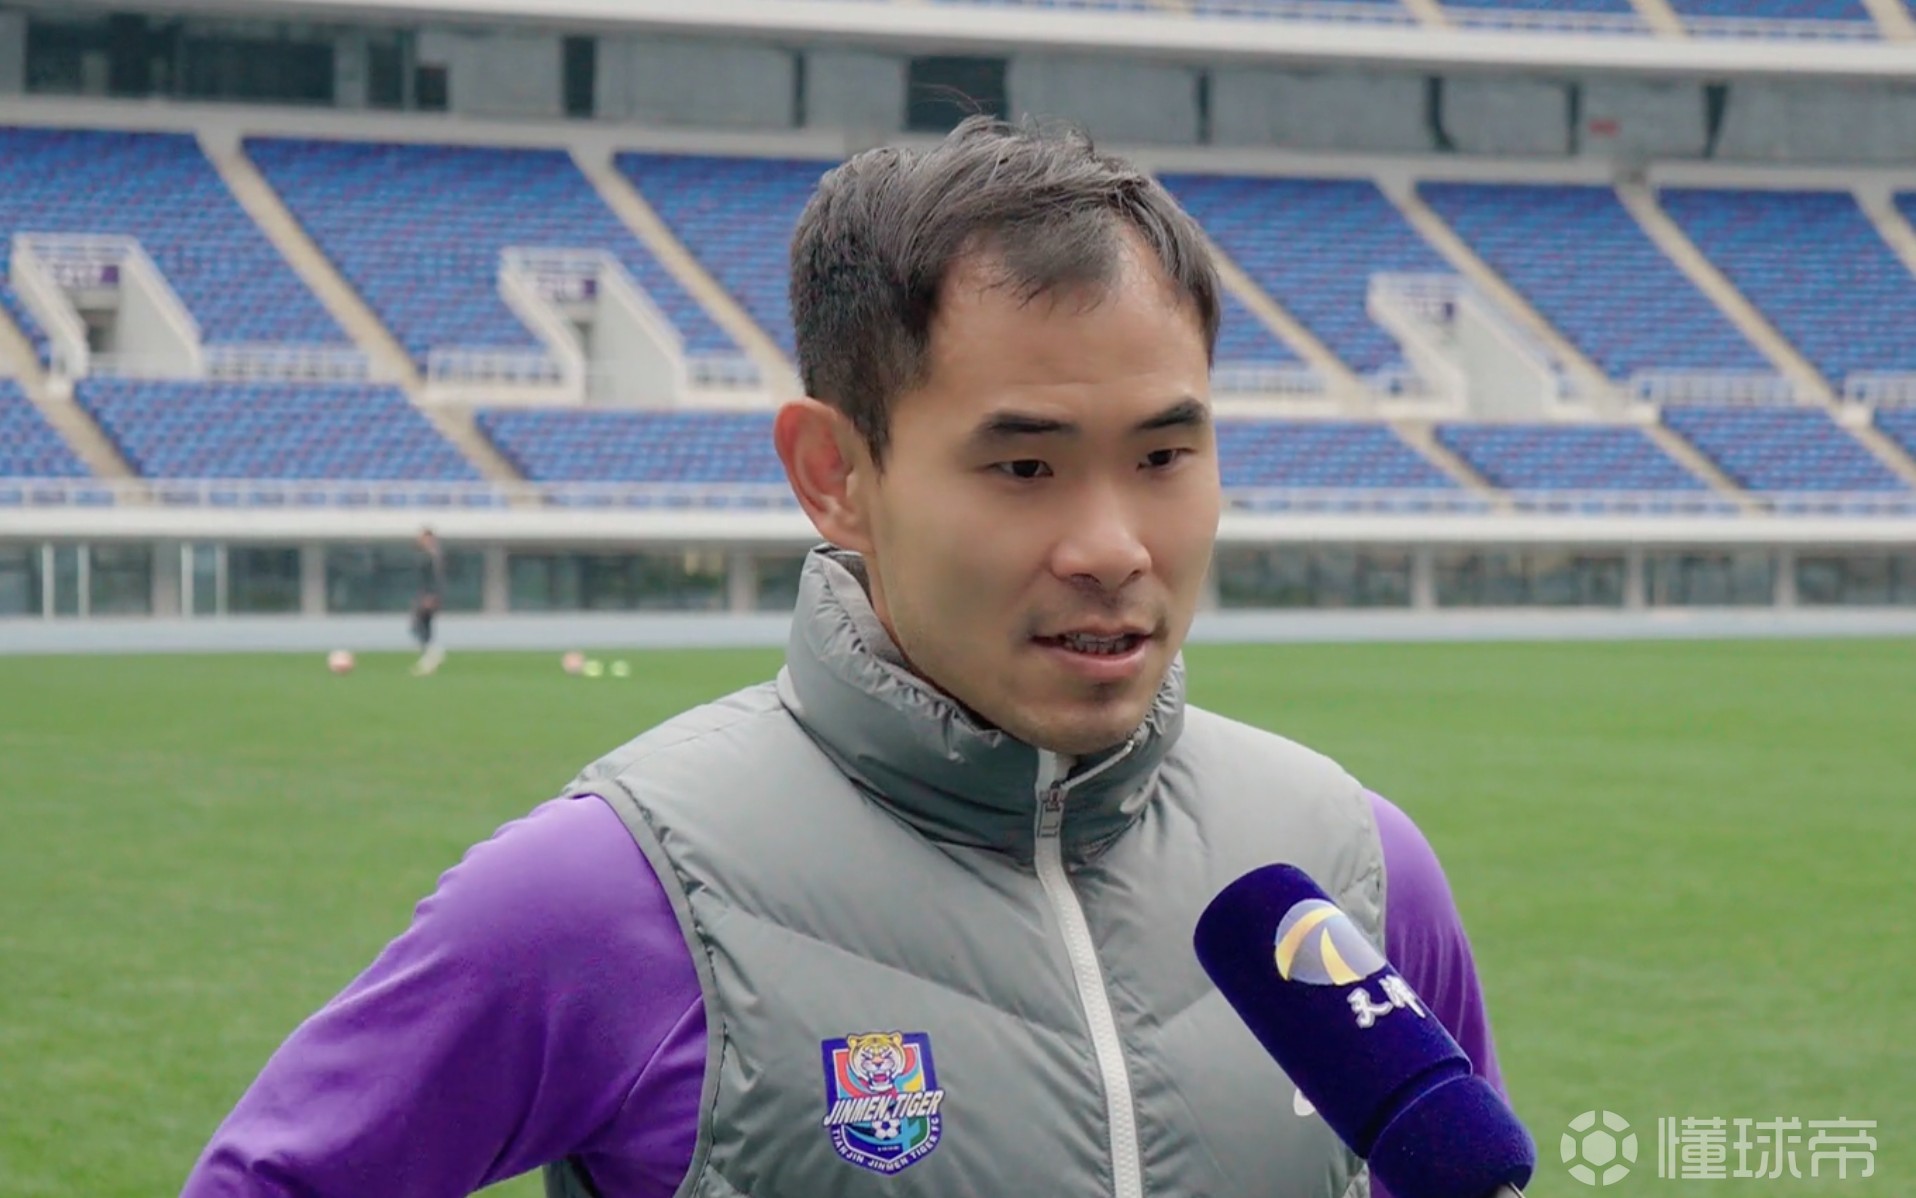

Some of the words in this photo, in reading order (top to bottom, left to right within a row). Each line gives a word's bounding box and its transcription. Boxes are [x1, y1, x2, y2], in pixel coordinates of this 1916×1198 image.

[823, 1096, 891, 1125] JINMEN
[892, 1090, 944, 1117] TIGER
[832, 1129, 864, 1164] TIANJIN
[868, 1158, 909, 1171] JINMEN
[910, 1134, 940, 1160] TIGER
[932, 1116, 940, 1133] FC
